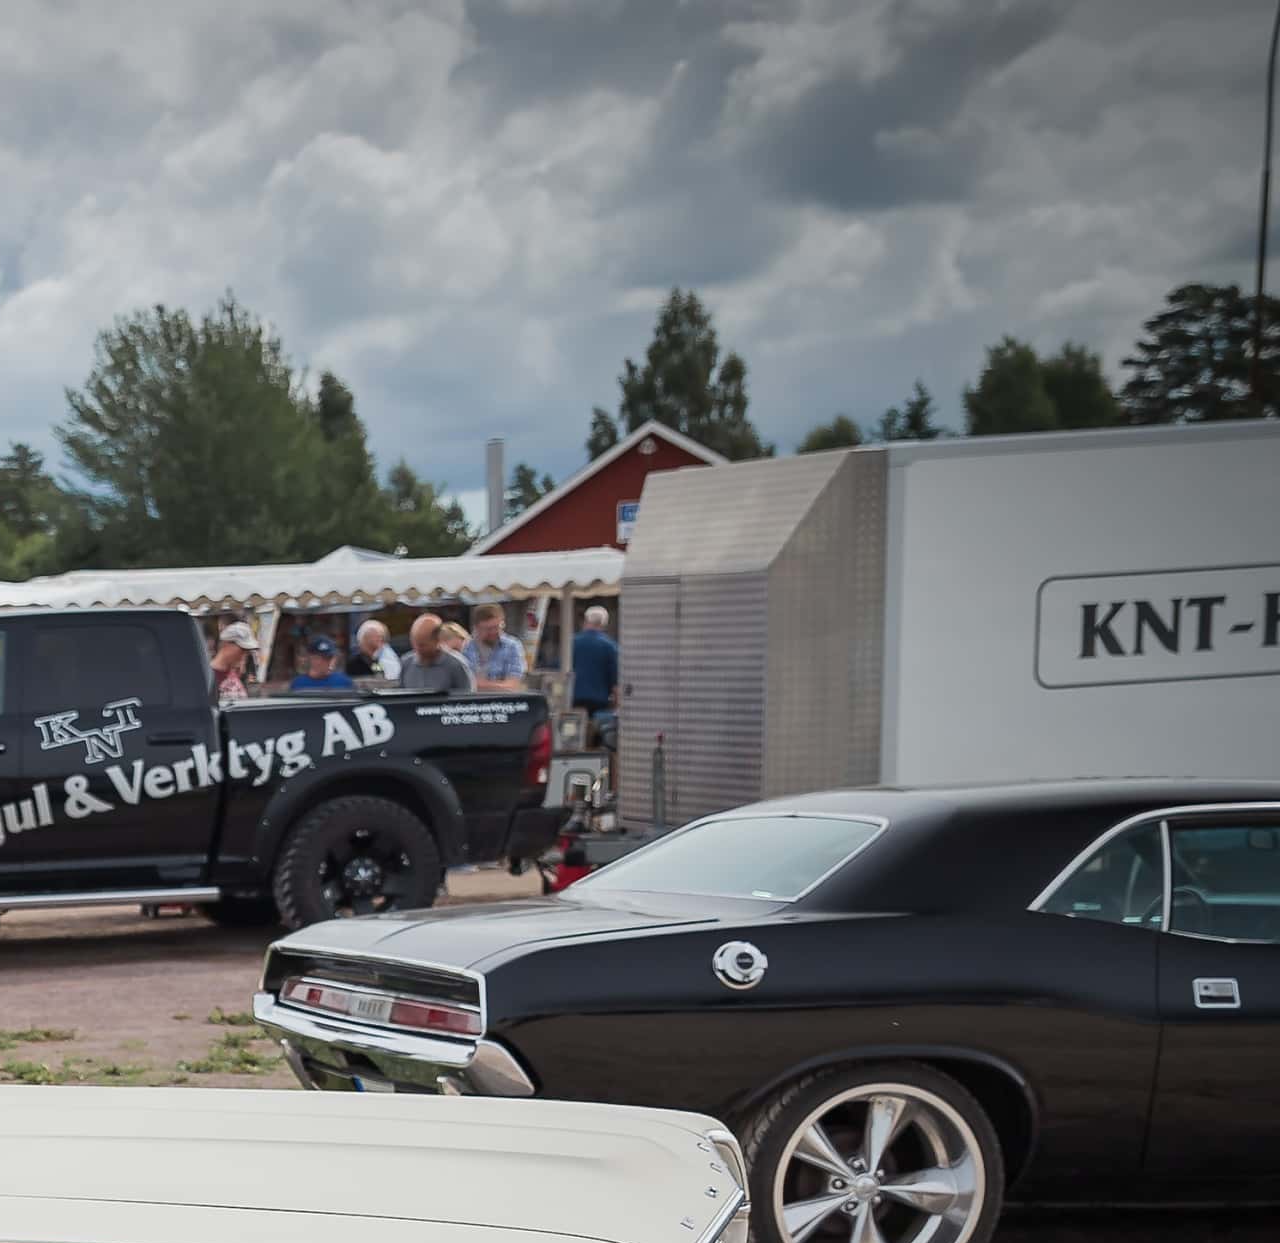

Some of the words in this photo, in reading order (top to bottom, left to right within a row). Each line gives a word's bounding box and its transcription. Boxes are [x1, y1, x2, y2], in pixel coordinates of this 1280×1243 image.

[63, 774, 114, 819] &
[105, 730, 311, 805] Verktyg
[322, 703, 395, 757] AB
